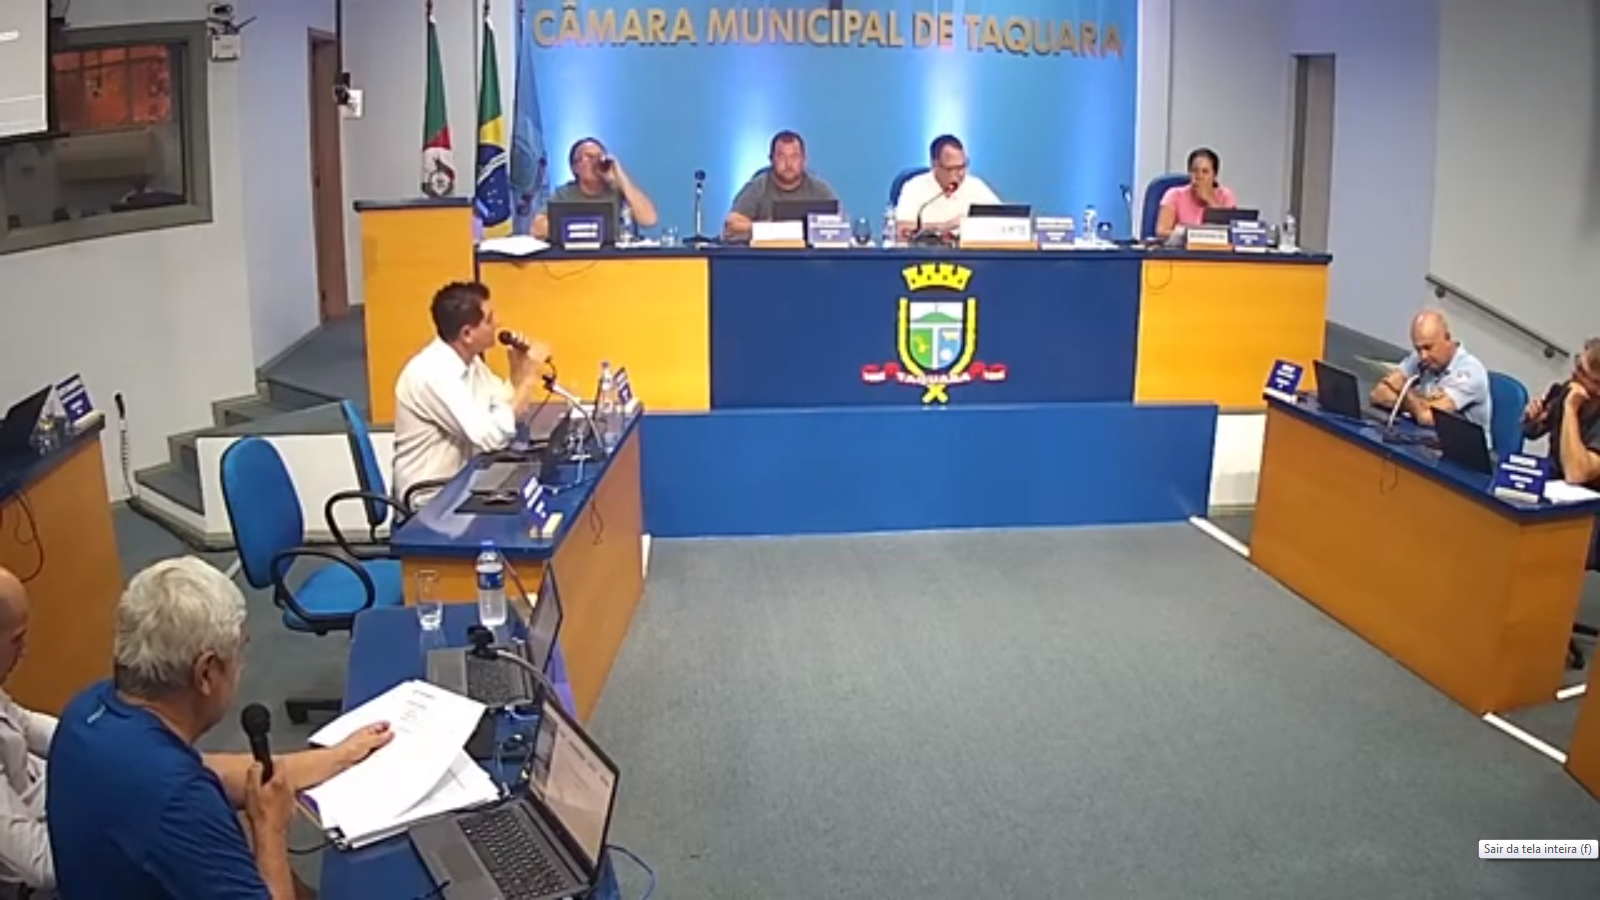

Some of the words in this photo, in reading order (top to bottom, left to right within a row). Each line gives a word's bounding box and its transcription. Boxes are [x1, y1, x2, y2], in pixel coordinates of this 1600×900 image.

[534, 2, 698, 48] CÂMARA
[706, 8, 906, 48] MUNICIPAL
[913, 12, 954, 48] DE
[963, 14, 1123, 58] TAQUARA
